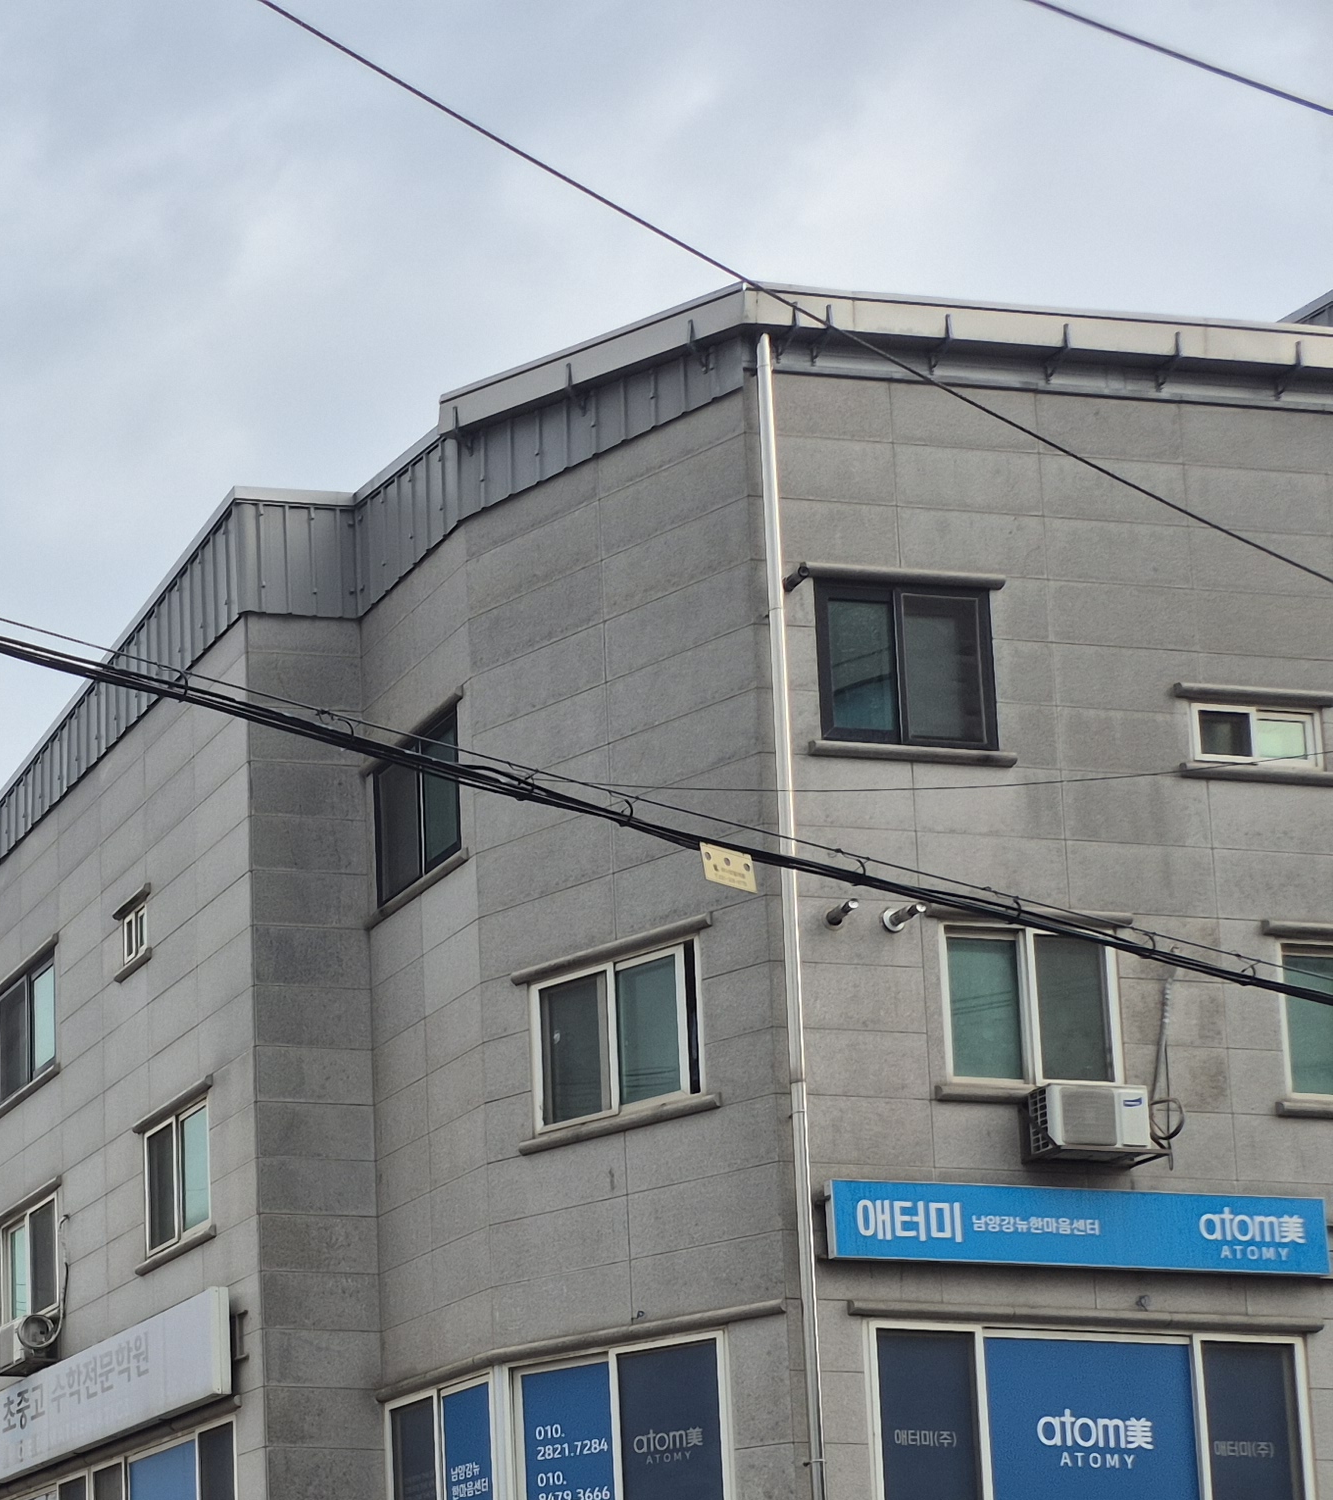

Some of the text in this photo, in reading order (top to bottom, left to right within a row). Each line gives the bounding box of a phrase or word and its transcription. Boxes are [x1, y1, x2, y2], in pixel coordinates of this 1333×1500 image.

[856, 1198, 963, 1243] 애터미
[1220, 1245, 1290, 1261] ATOMY
[2, 1331, 149, 1434] 초중고 수학전문학원
[535, 1424, 565, 1440] 010.
[894, 1429, 957, 1448] 애터미(주)
[536, 1438, 608, 1461] 2821.7284
[646, 1449, 692, 1465] ATOMY
[1059, 1451, 1136, 1469] ATOMY
[537, 1471, 567, 1487] 010.
